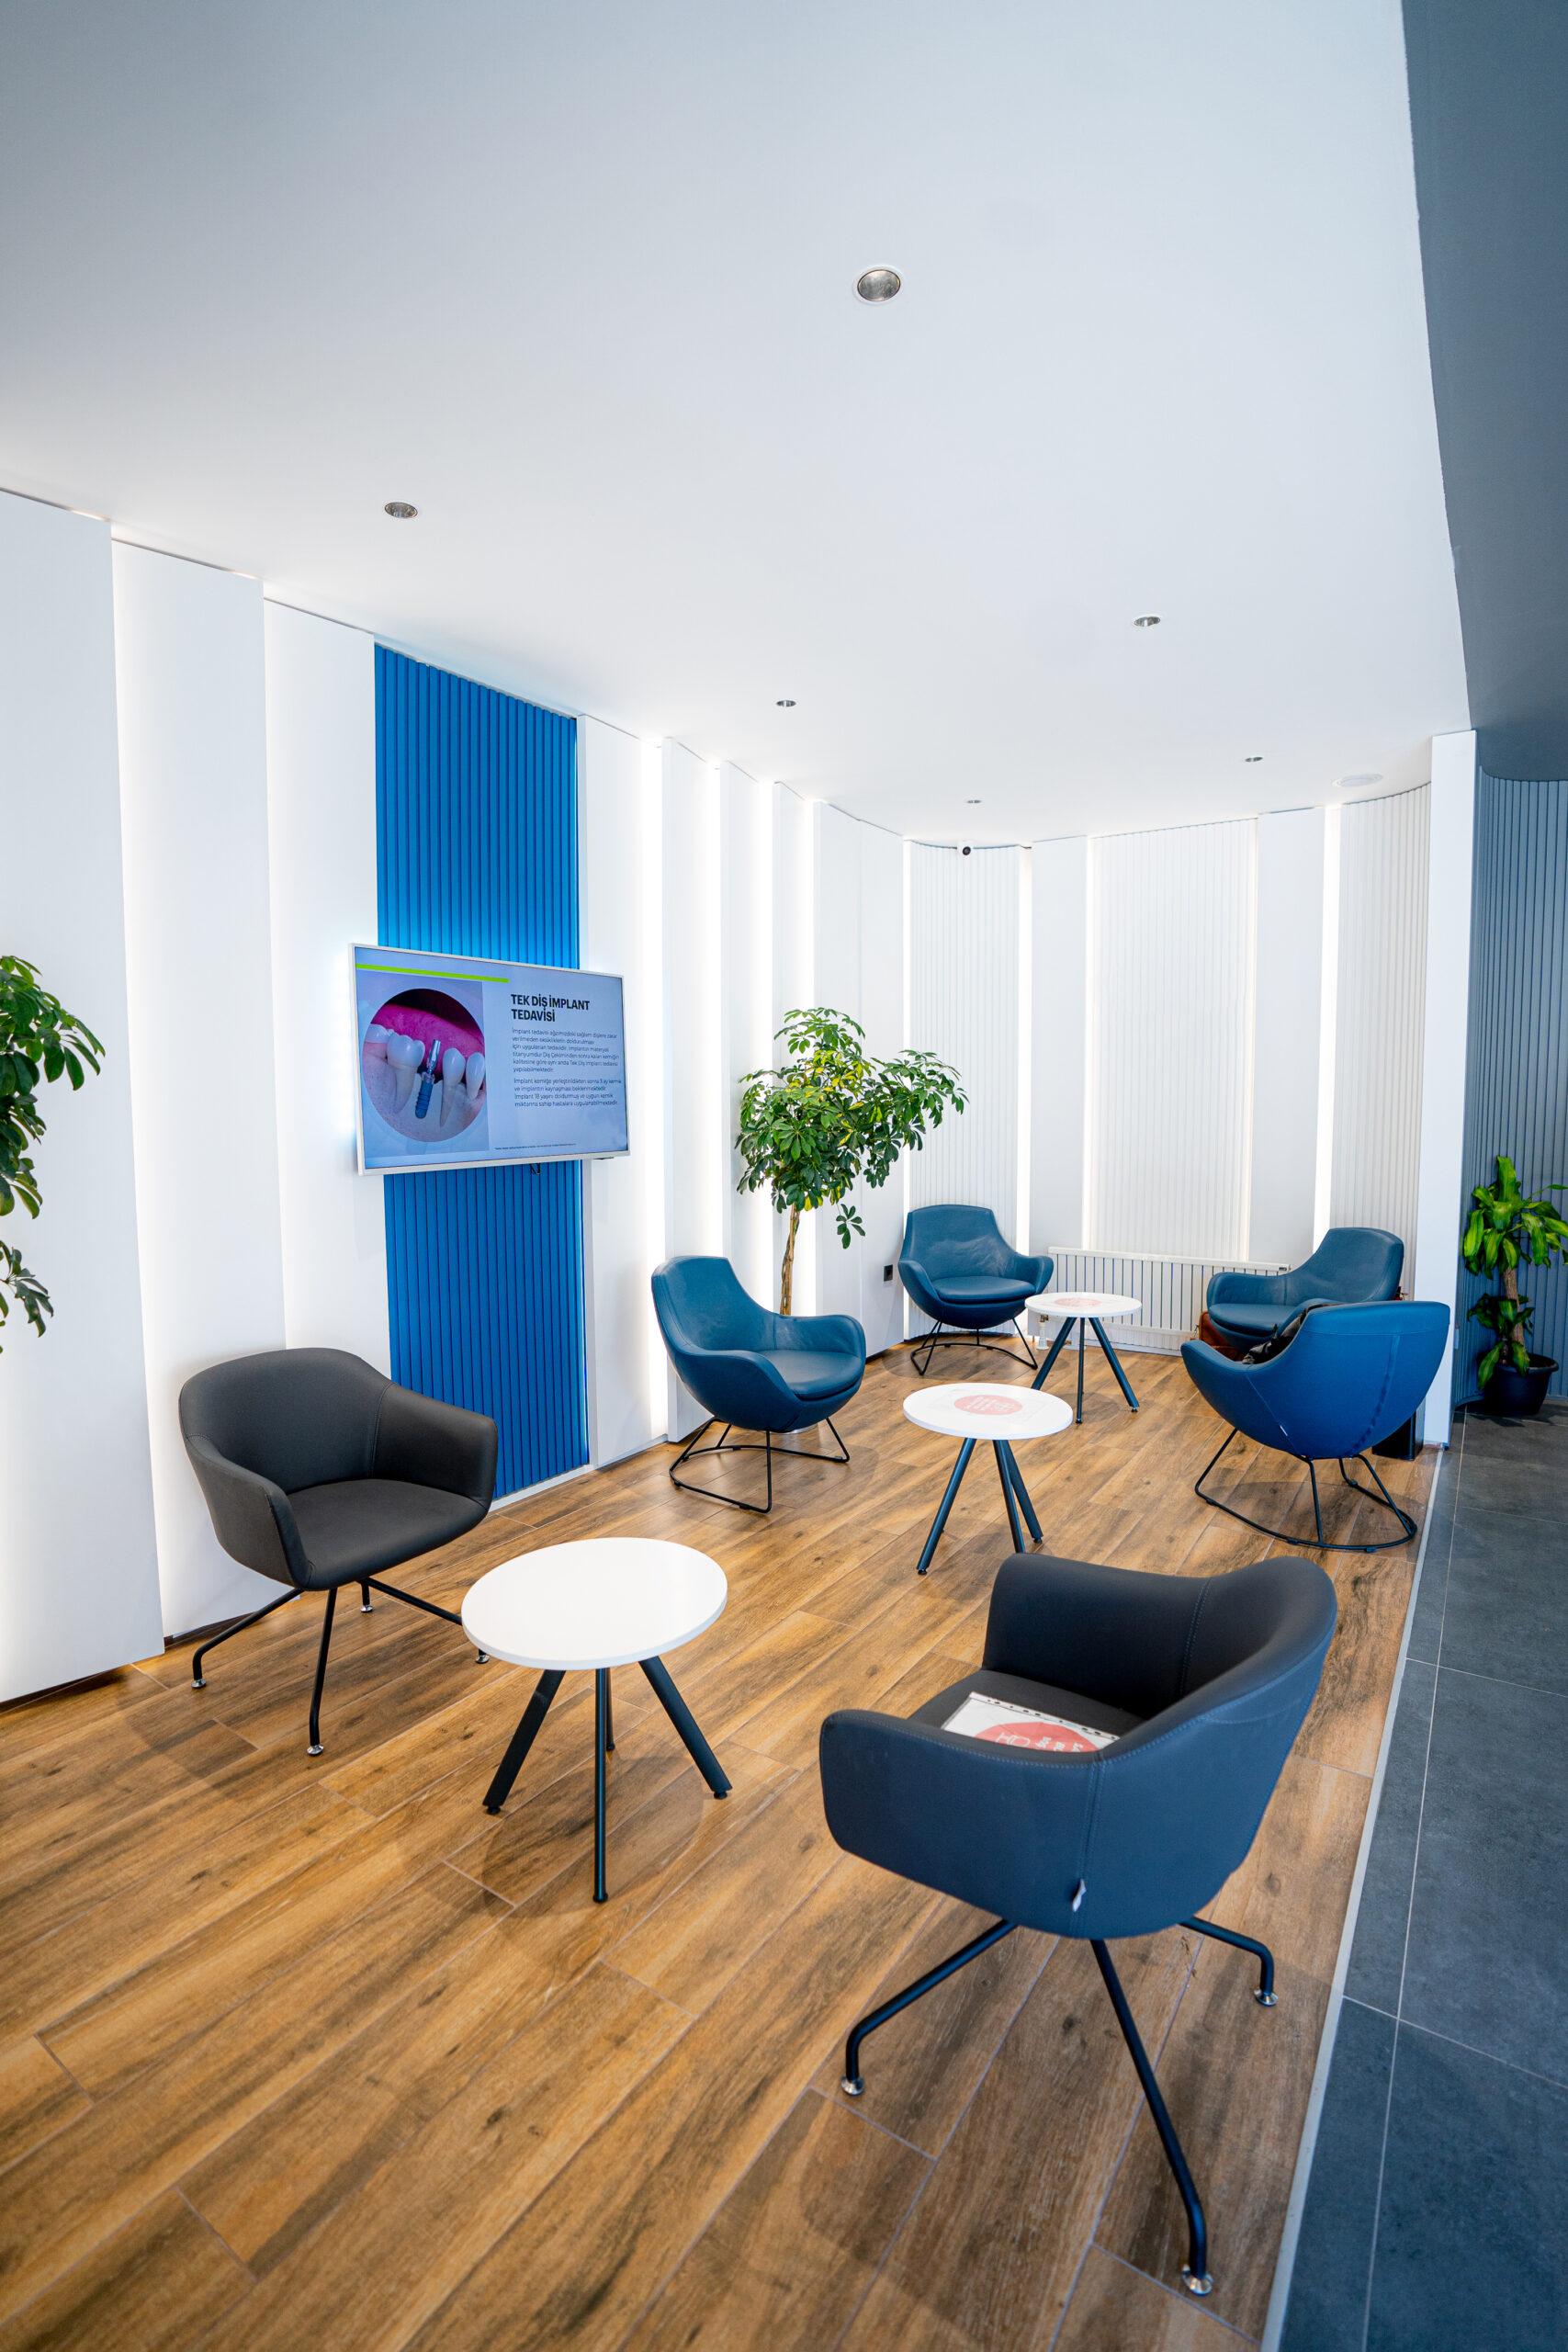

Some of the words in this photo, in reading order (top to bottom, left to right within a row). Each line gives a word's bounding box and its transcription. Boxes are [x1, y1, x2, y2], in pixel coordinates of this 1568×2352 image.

[511, 994, 530, 1006] TEK
[532, 993, 547, 1009] DİŞ
[549, 995, 590, 1011] İMPLANT
[512, 1008, 556, 1022] TEDAVİSİ
